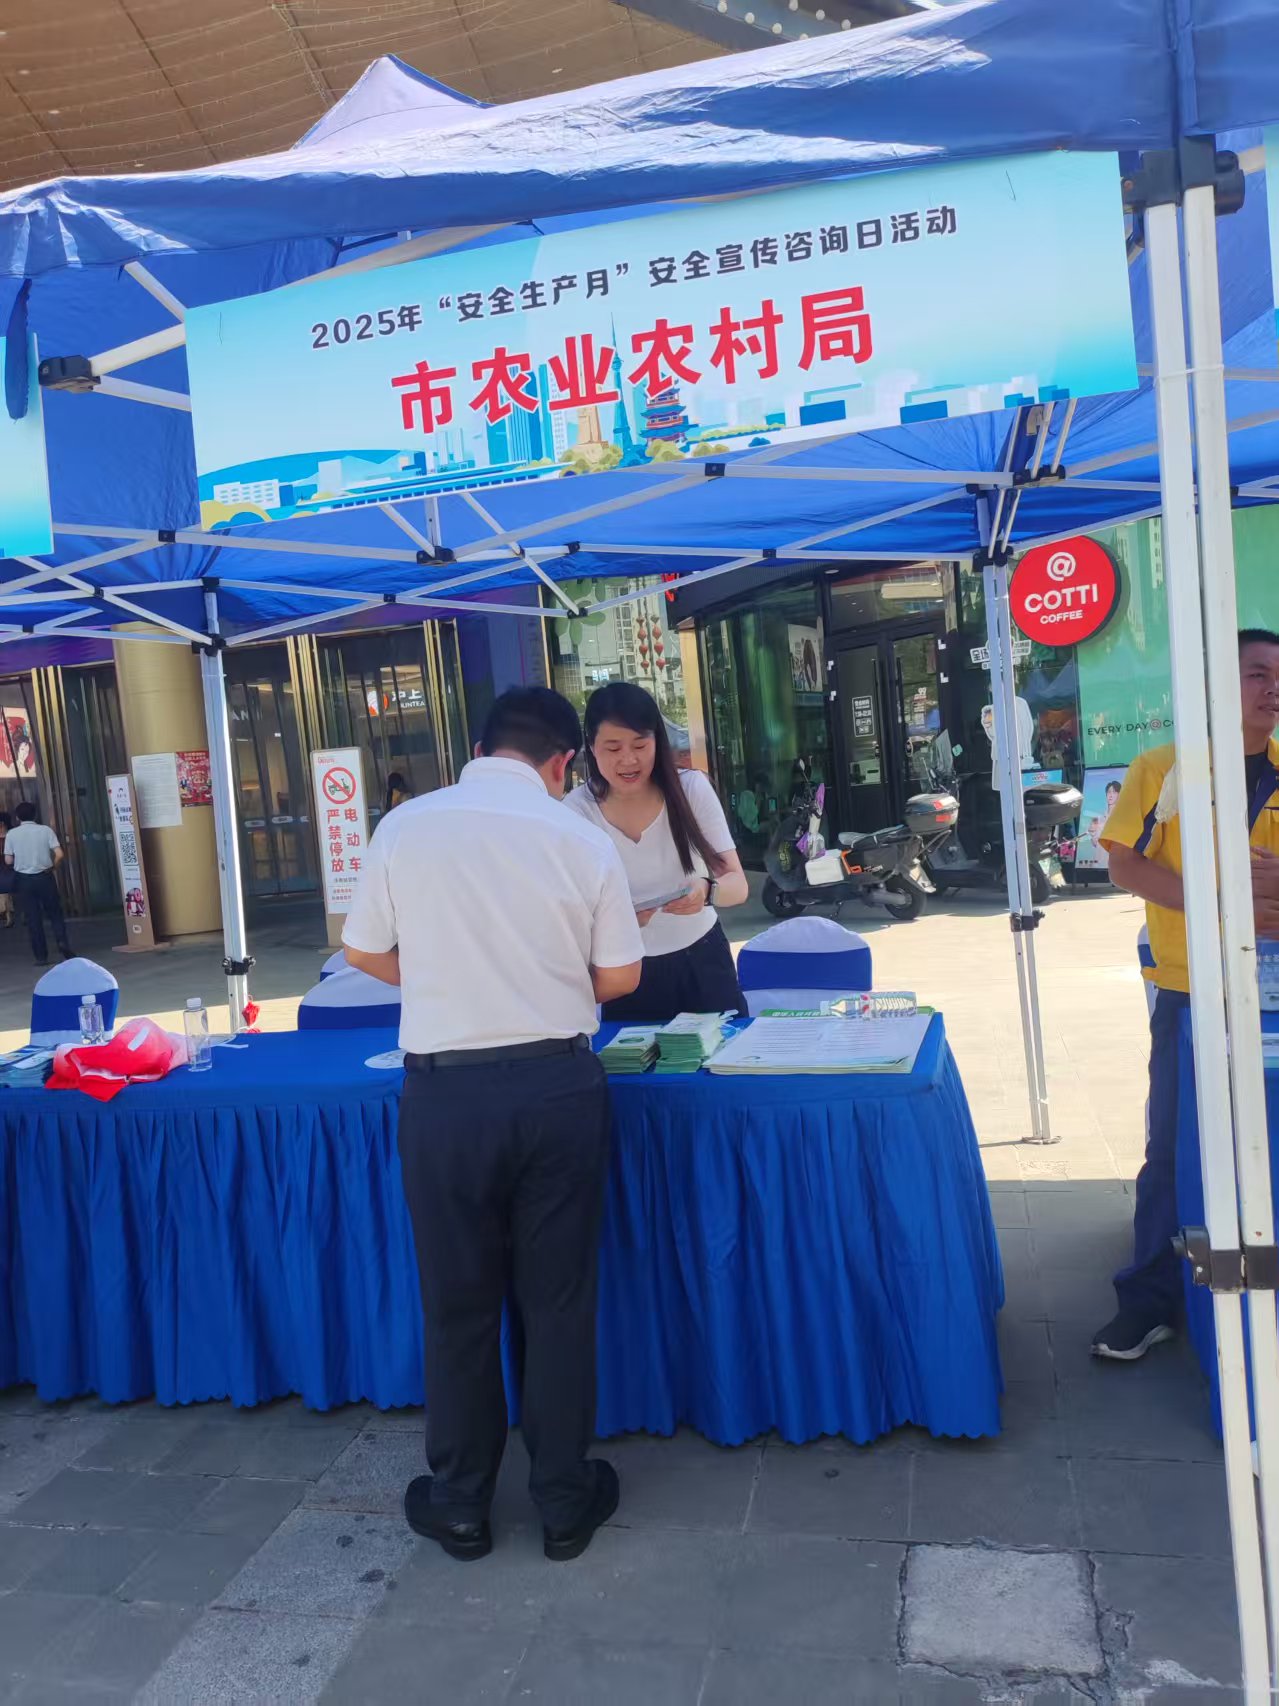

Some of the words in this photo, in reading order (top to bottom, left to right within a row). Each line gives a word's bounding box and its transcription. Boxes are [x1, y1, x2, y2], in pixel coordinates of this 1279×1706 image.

[391, 286, 874, 434] 市农业农村局
[1024, 583, 1099, 613] COTTI
[1039, 610, 1083, 625] COFFEE
[1087, 725, 1121, 736] EVERY
[326, 808, 345, 873] 严禁停放
[344, 807, 362, 872] 电动车
